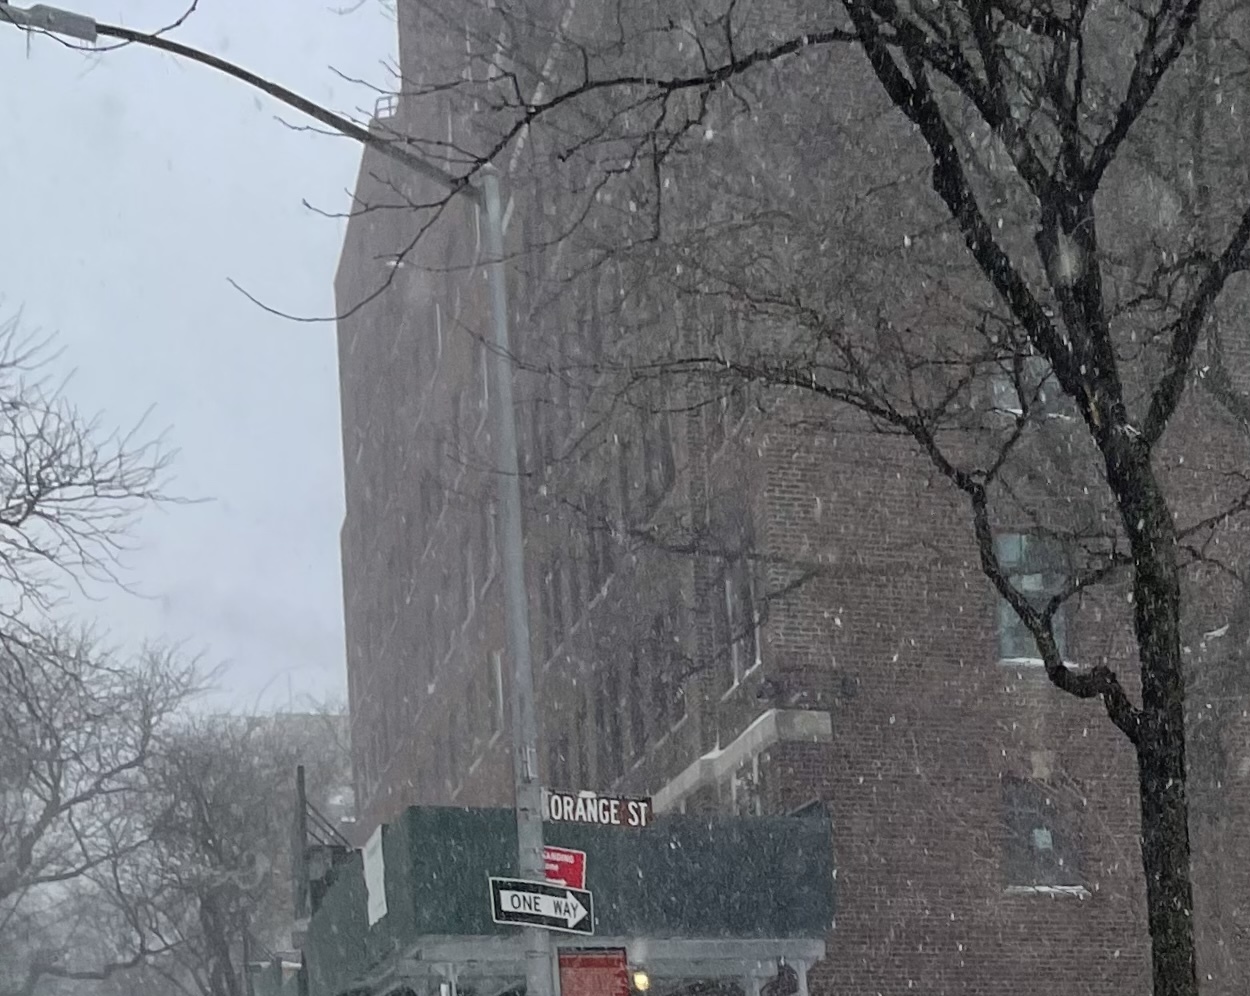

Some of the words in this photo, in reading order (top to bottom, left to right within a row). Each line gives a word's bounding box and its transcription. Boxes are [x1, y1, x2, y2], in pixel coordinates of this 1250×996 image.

[551, 795, 621, 825] ORANGE
[627, 801, 648, 827] ST
[510, 893, 542, 913] ONE
[553, 900, 579, 919] WAY
